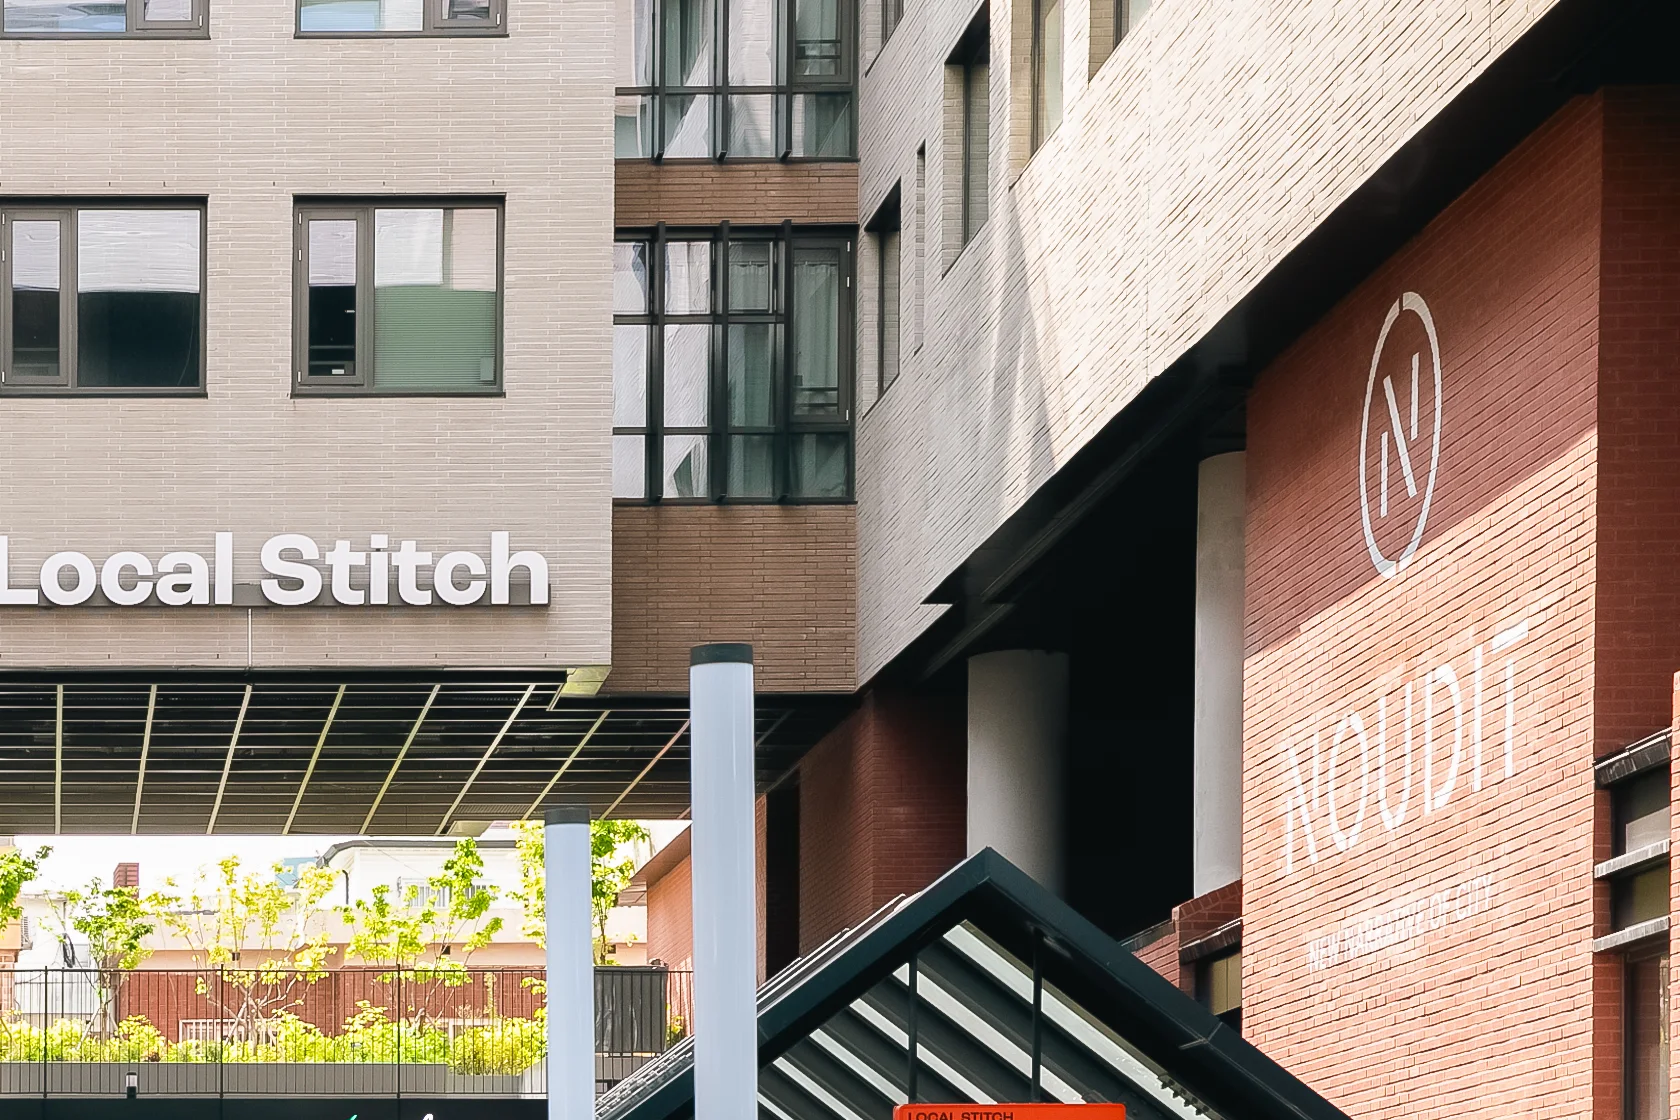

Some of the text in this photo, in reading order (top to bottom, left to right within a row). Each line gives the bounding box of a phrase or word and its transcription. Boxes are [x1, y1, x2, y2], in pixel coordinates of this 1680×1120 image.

[259, 531, 550, 606] Stitch
[1280, 619, 1528, 874] NOUDIT
[1429, 889, 1452, 929] OF
[1455, 875, 1493, 921] CITY
